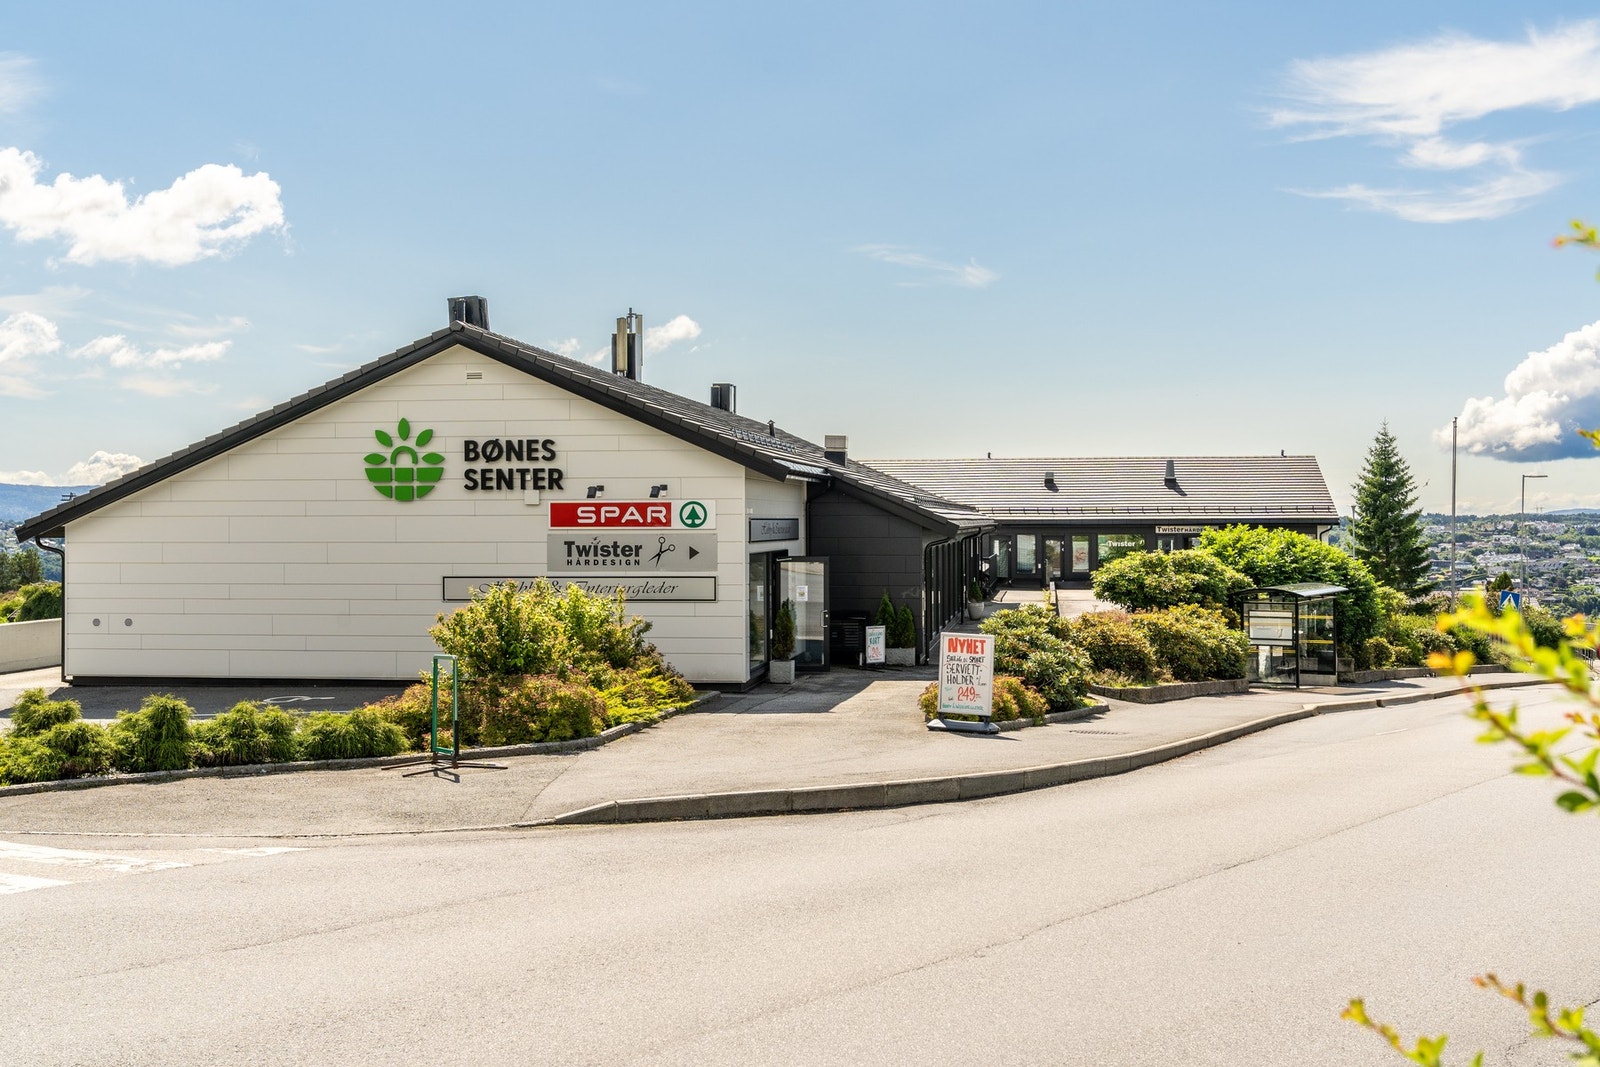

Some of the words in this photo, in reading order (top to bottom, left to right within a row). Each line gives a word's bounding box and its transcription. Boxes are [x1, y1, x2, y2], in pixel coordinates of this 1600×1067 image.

[464, 438, 557, 463] BØNES
[463, 468, 564, 491] SENTER
[576, 505, 667, 524] SPAR
[563, 538, 643, 558] Twister
[1108, 540, 1136, 548] Twister
[566, 558, 641, 566] HÅRDESIGN
[551, 579, 562, 593] &
[567, 580, 679, 599] Interirgleder
[947, 637, 986, 655] NYHET
